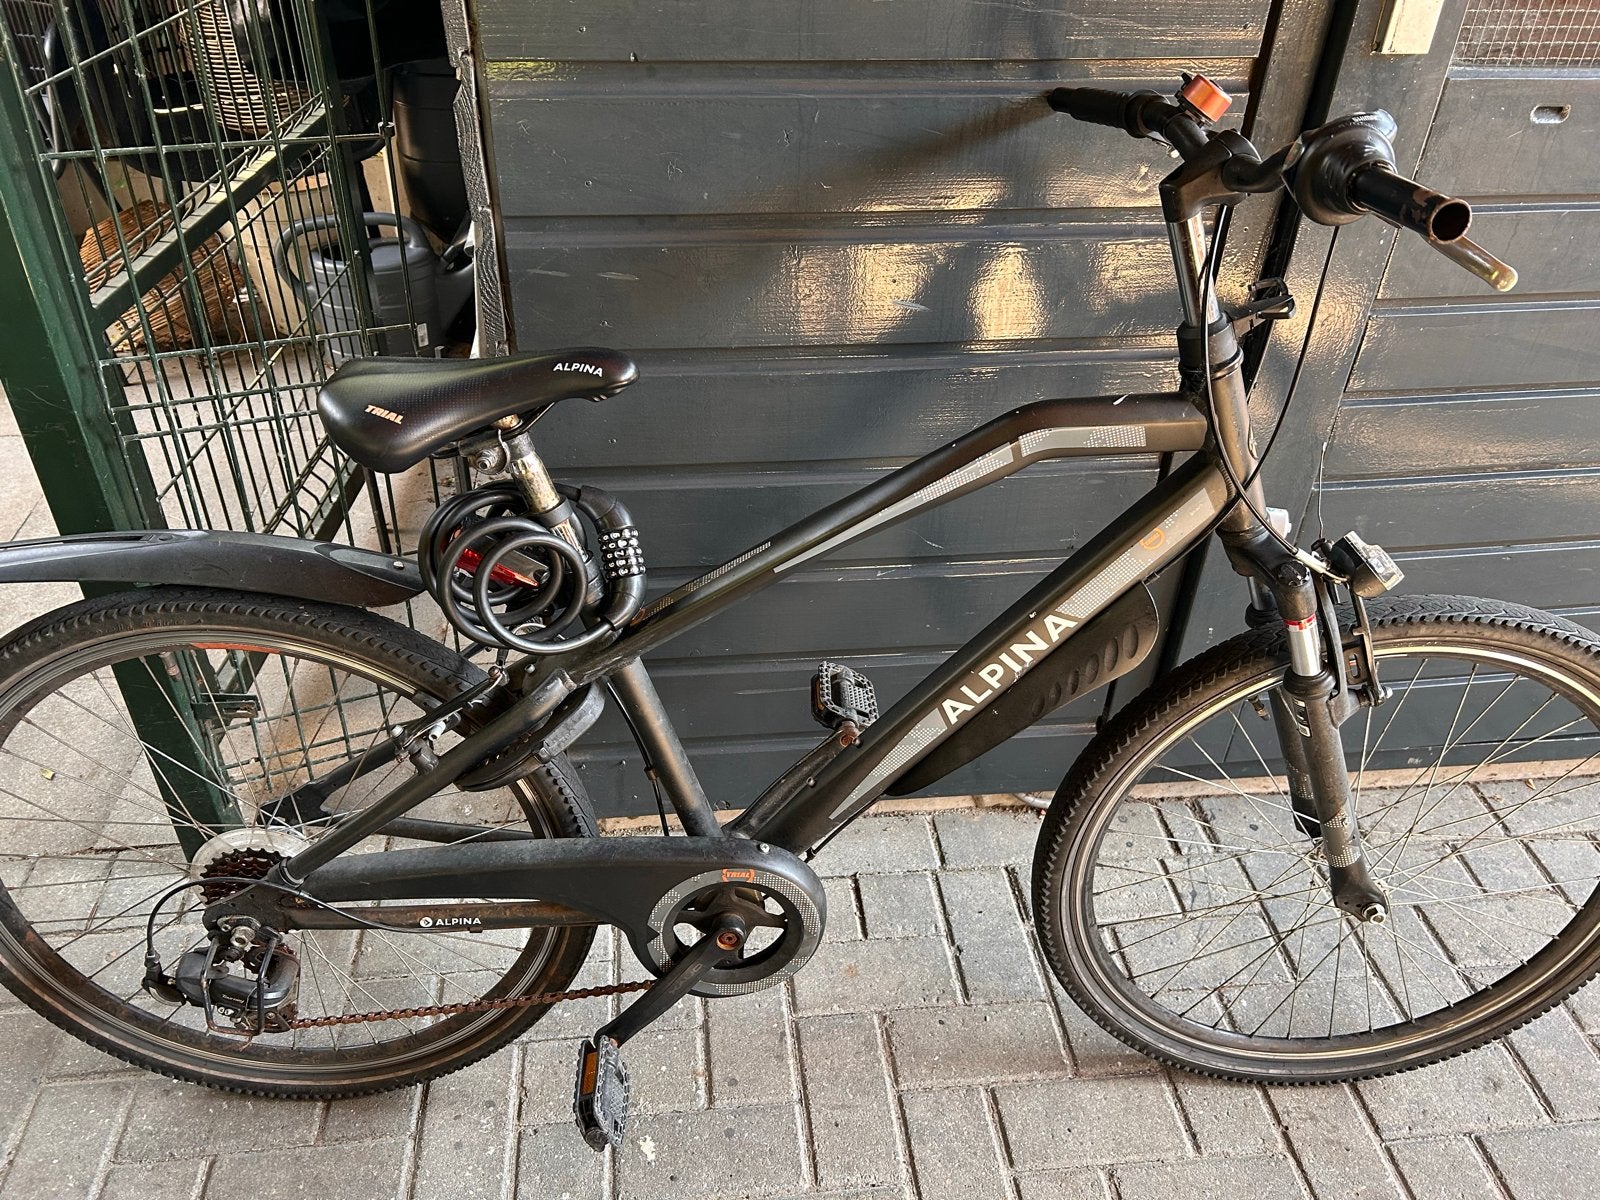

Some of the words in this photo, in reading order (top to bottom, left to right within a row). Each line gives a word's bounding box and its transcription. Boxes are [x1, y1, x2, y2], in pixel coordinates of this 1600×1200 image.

[553, 362, 603, 378] ALPINA
[364, 404, 404, 425] TRIAL
[941, 614, 1078, 726] ALPINA
[435, 917, 482, 926] ALPINA
